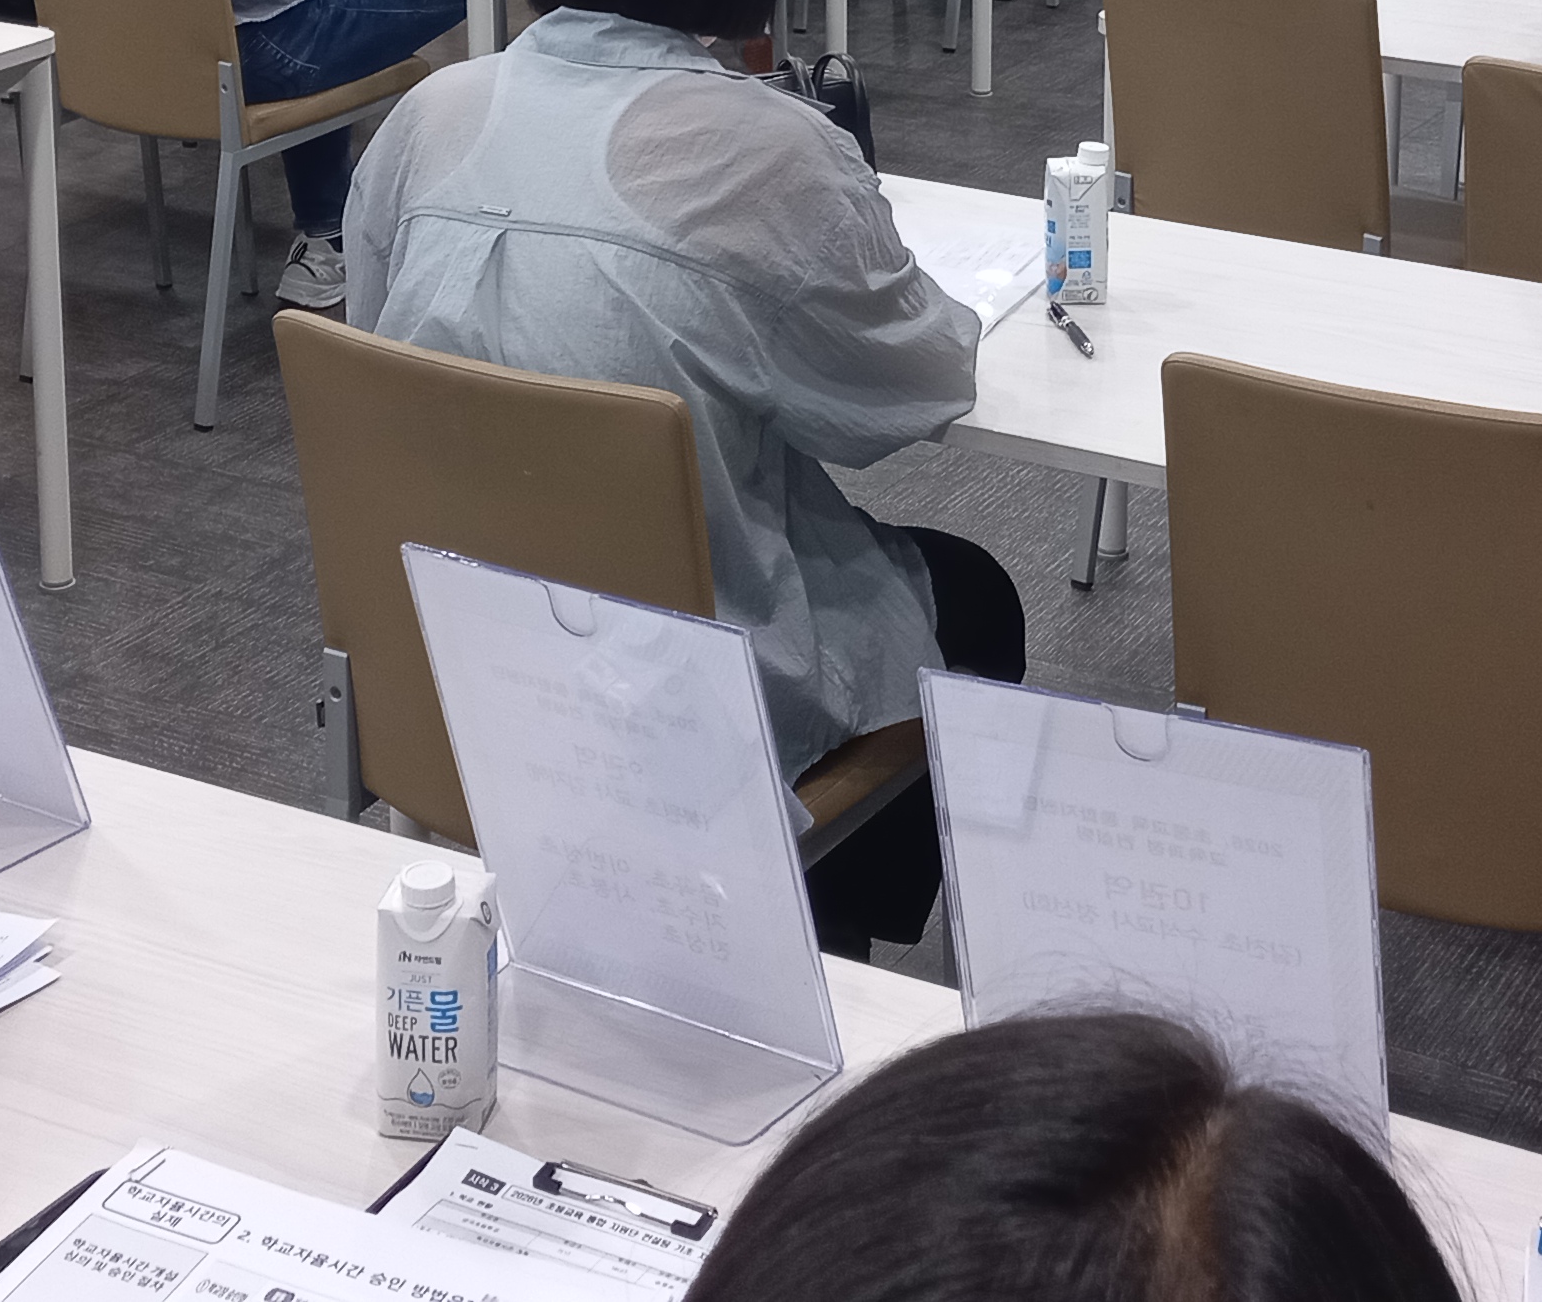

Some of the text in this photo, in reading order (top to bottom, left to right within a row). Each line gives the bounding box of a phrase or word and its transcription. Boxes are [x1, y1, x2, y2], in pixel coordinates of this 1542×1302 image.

[409, 974, 433, 984] JUST
[387, 986, 463, 1033] 기픈 물
[388, 1012, 418, 1032] DEEP
[388, 1029, 458, 1065] WATER
[126, 1185, 232, 1227] 학교자율시간의
[72, 1238, 180, 1283] 학교자율시간 개설
[108, 1266, 137, 1283] 승인
[136, 1275, 165, 1294] 절차
[236, 1229, 251, 1244] 2.
[260, 1235, 366, 1279] 학교자율시간
[368, 1271, 407, 1293] 승인
